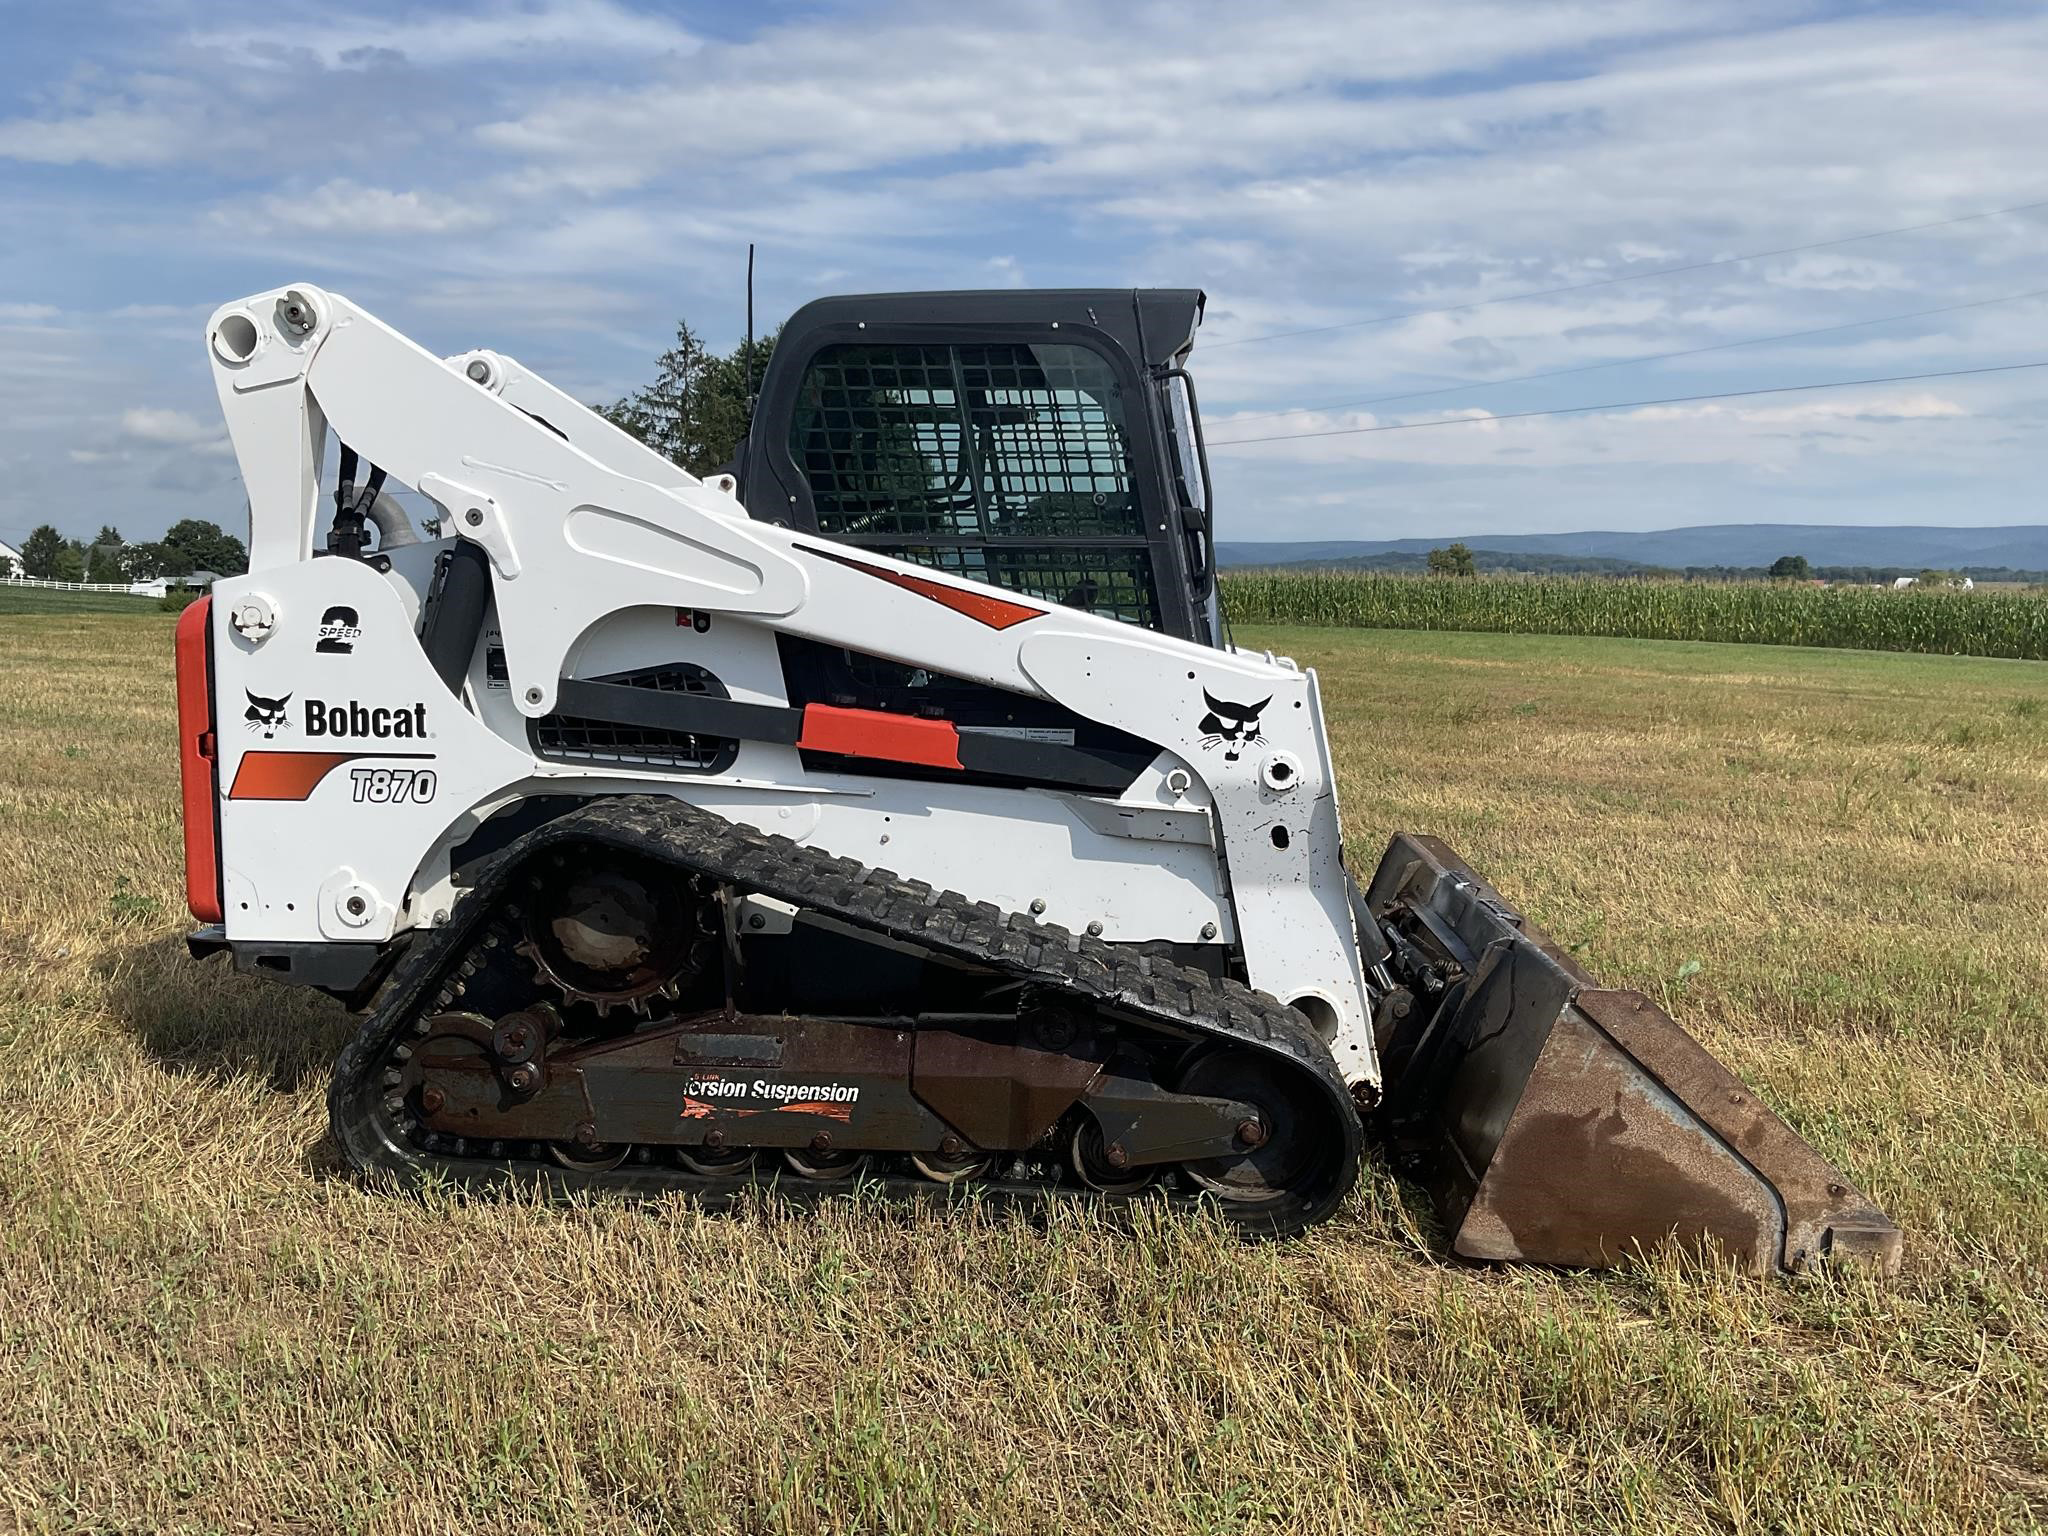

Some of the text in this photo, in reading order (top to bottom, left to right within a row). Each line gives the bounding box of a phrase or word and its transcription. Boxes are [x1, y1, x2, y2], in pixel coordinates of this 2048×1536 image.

[315, 605, 359, 655] 2
[318, 627, 361, 638] SPEED
[305, 699, 427, 738] Bobcat
[350, 768, 437, 804] T870
[751, 1080, 859, 1104] Suspension
